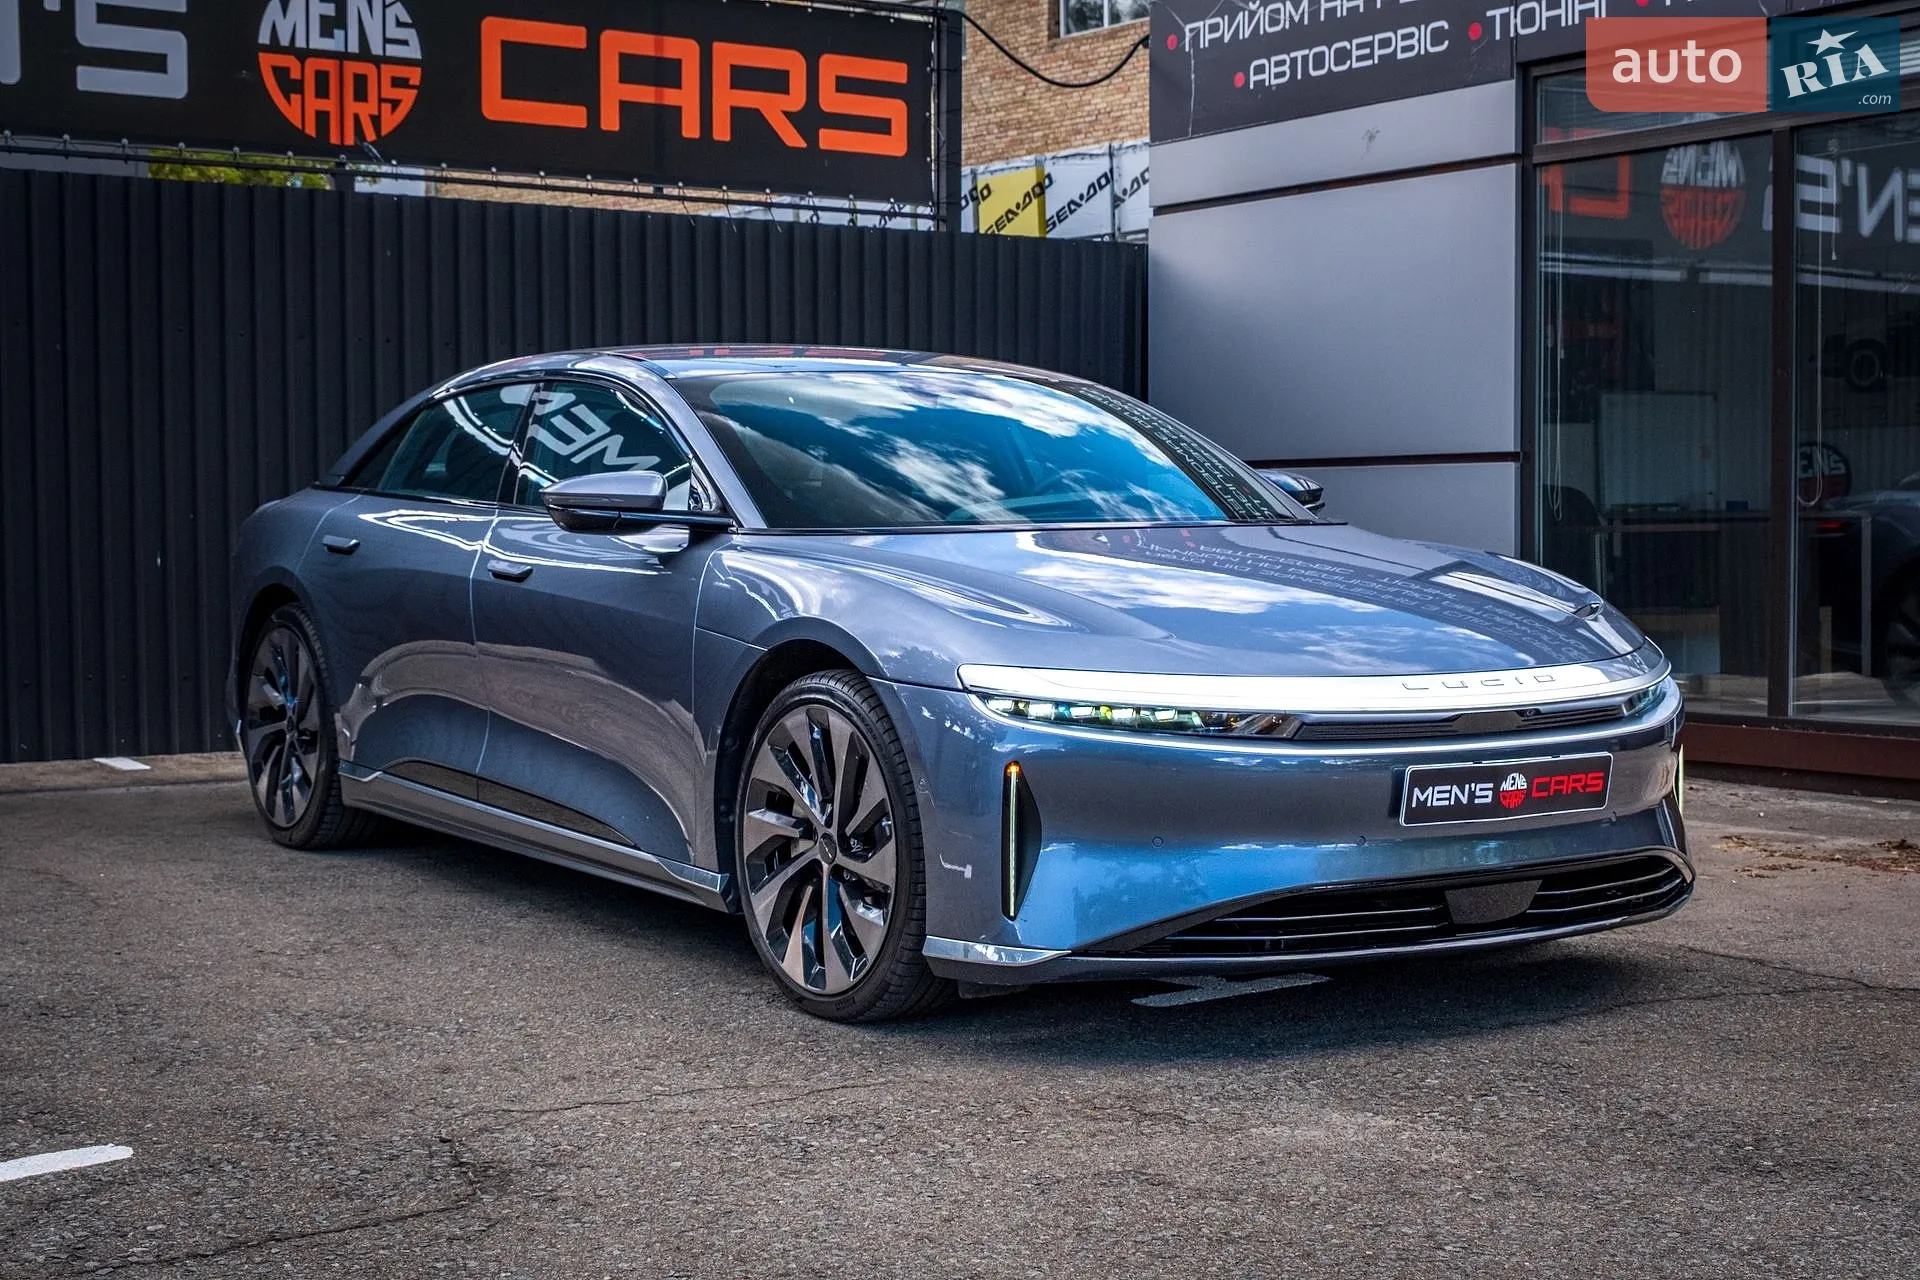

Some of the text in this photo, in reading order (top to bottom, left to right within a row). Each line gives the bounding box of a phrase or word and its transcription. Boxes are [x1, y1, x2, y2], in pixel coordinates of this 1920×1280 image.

[1185, 0, 1308, 52] ПРИЙОМ
[1250, 20, 1449, 89] АВТОСЕРВІС
[258, 52, 422, 146] CARS
[481, 16, 907, 157] CARS
[1402, 675, 1556, 690] LUCID
[1412, 782, 1493, 808] MEN'S
[1532, 771, 1604, 798] CARS
